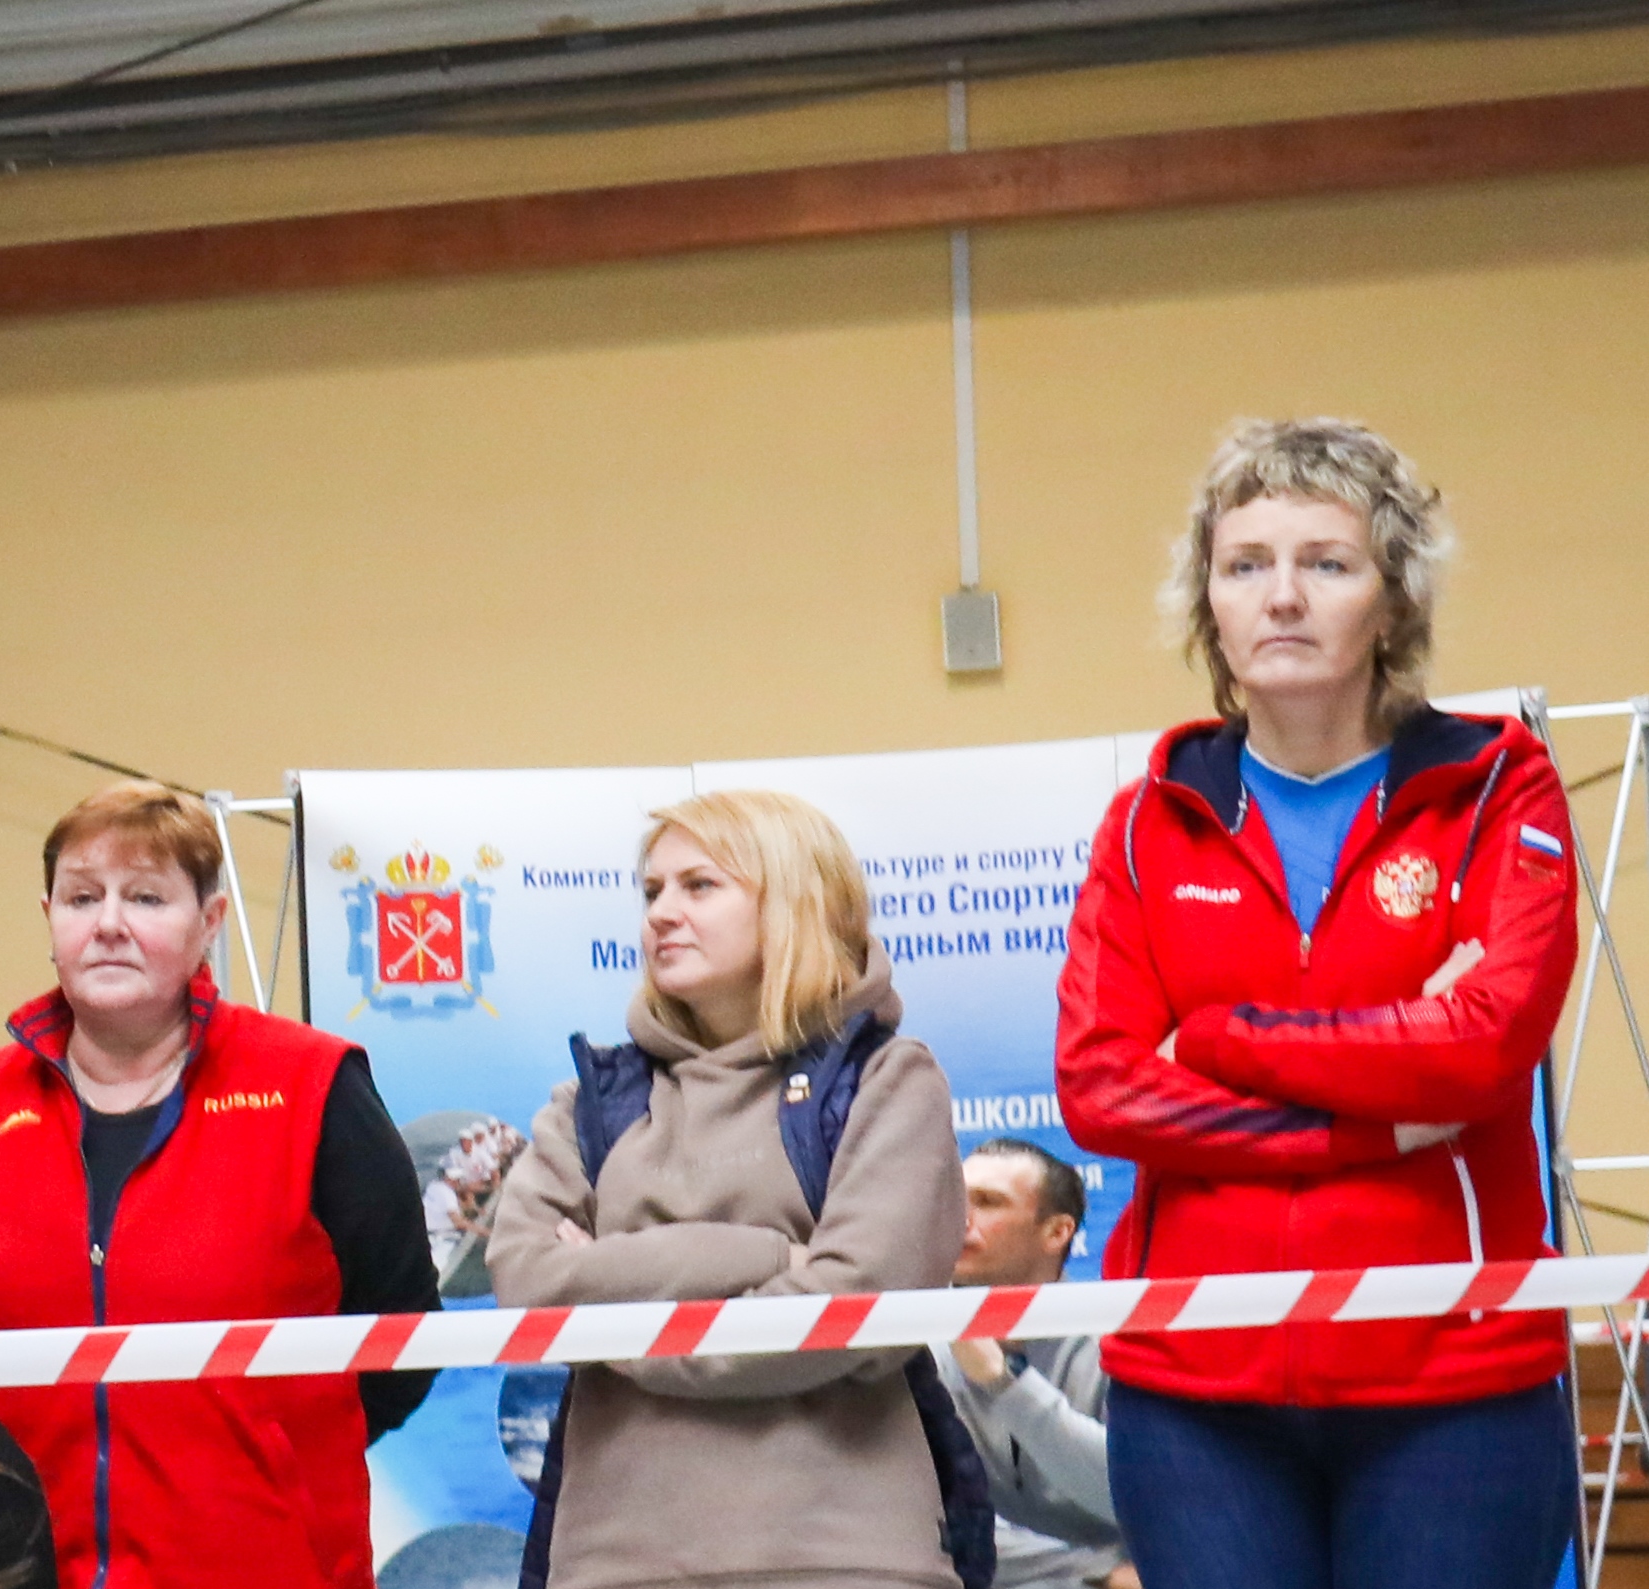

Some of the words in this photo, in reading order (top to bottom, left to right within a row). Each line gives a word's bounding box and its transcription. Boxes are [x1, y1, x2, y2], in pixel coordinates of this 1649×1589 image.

[522, 864, 622, 889] Комитет
[955, 852, 969, 873] и
[978, 846, 1064, 874] спорту
[872, 890, 936, 917] его
[204, 1090, 285, 1114] RUSSIA
